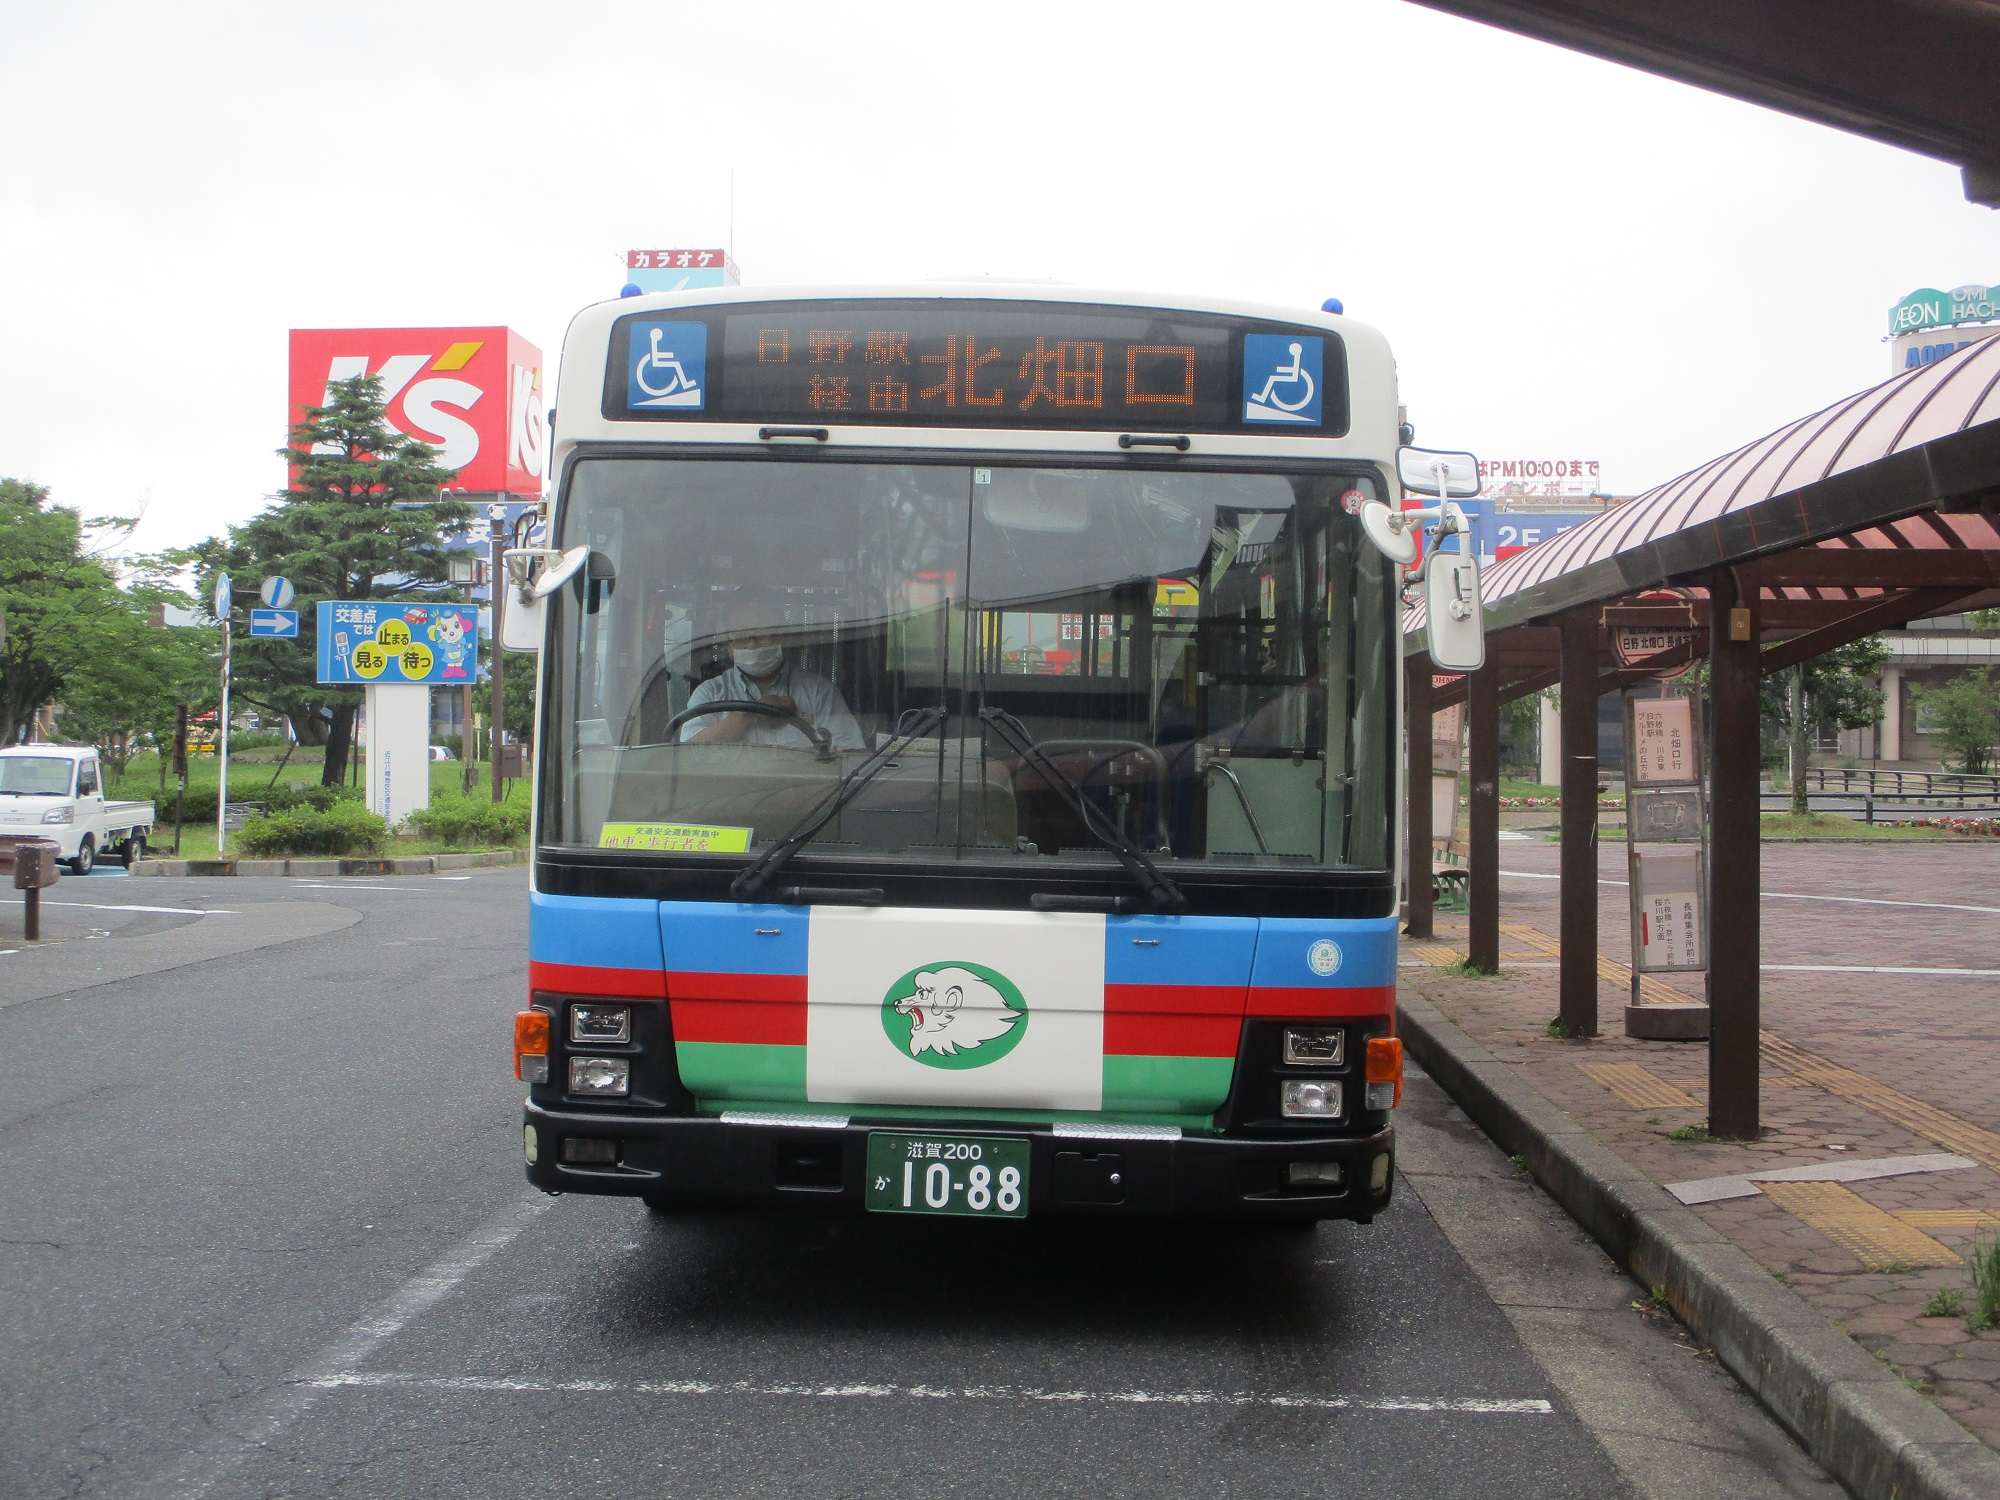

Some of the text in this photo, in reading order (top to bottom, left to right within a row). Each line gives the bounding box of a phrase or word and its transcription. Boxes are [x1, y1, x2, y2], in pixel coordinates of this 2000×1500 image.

[635, 252, 713, 267] カラオケ
[758, 329, 911, 365] 日野駅
[920, 334, 1195, 410] 北畑口
[809, 374, 908, 411] 経由
[508, 364, 542, 477] K's
[335, 608, 377, 624] 交差点
[353, 624, 374, 635] では
[378, 629, 410, 645] 止まる
[1641, 636, 1664, 649] 北畑口
[355, 651, 383, 669] 見る
[403, 651, 431, 669] 待つ
[1646, 712, 1655, 737] 日野駅
[1671, 728, 1682, 770] 北畑口行
[605, 835, 709, 852] 他車・歩行者を
[1655, 898, 1665, 941] 桜川駅方面
[907, 1141, 982, 1160] 滋賀200
[874, 1161, 1021, 1212] か 10-88
